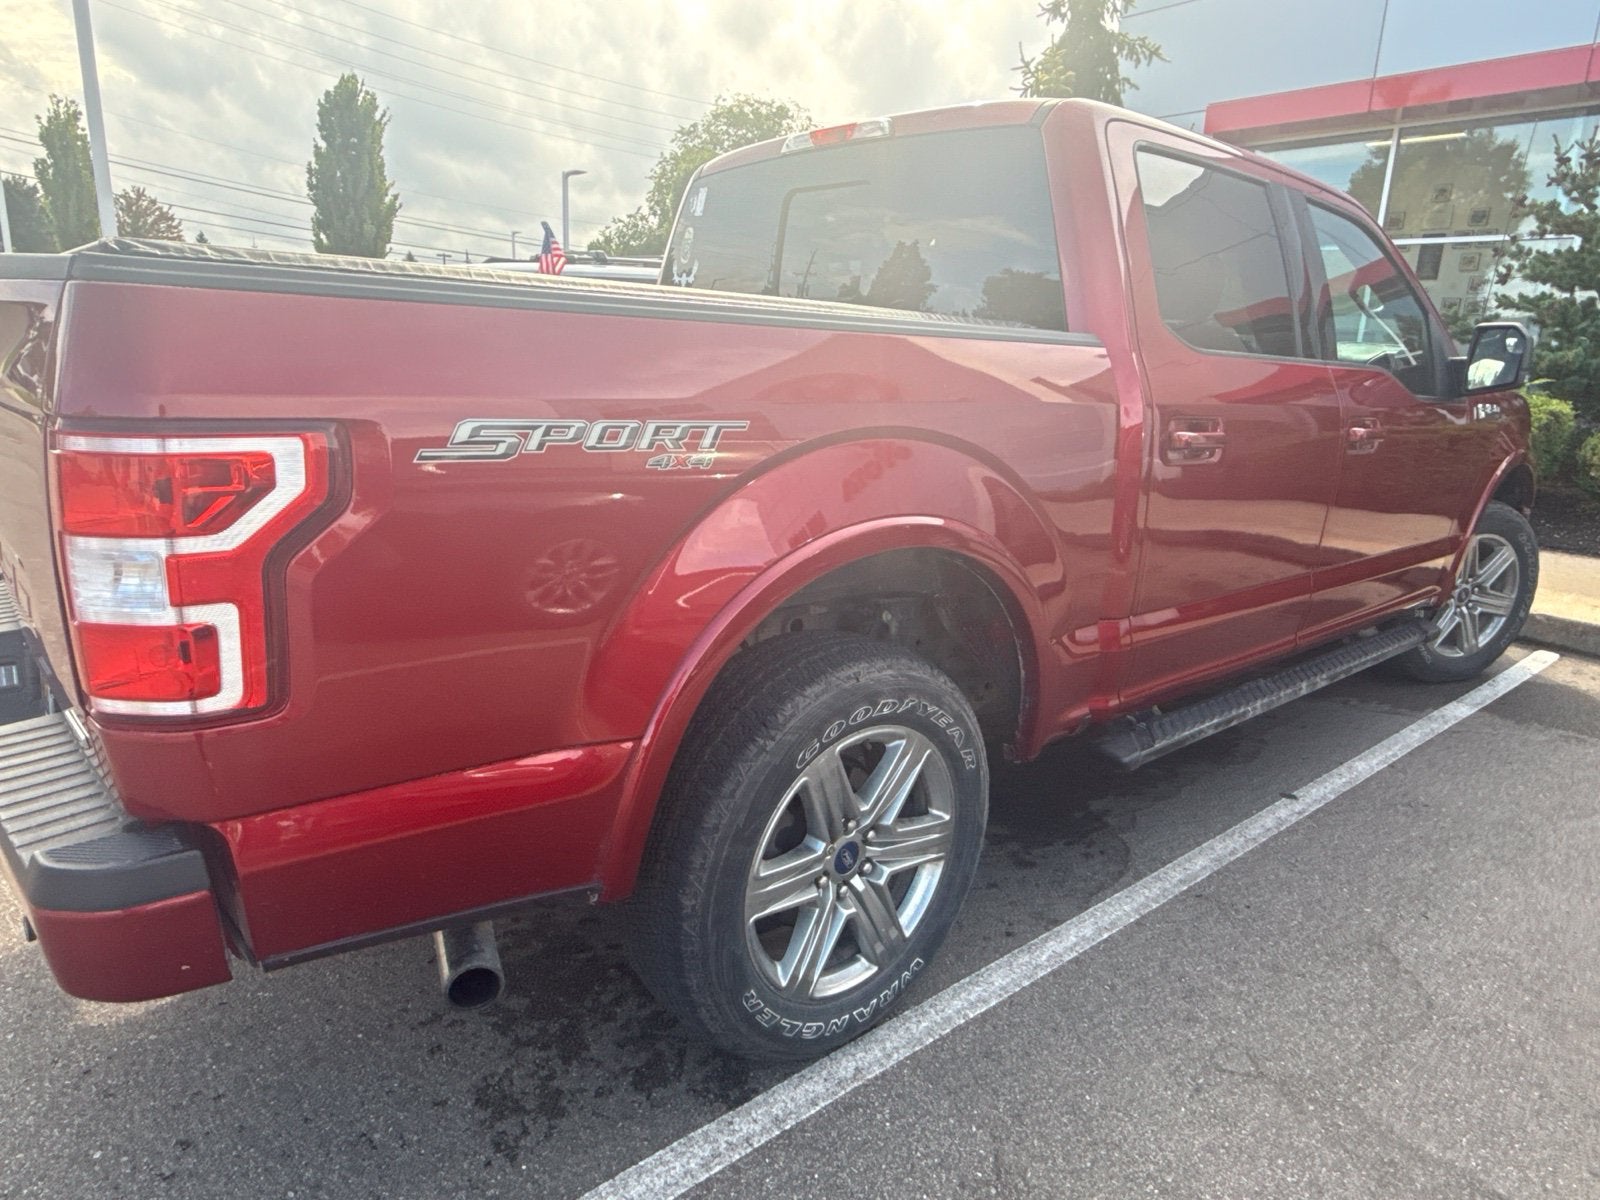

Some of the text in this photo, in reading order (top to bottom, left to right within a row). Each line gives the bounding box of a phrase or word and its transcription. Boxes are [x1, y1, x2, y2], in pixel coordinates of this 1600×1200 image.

[413, 418, 750, 463] SPORT
[796, 698, 976, 770] GOODYEAR
[742, 957, 924, 1039] WRANGLER
